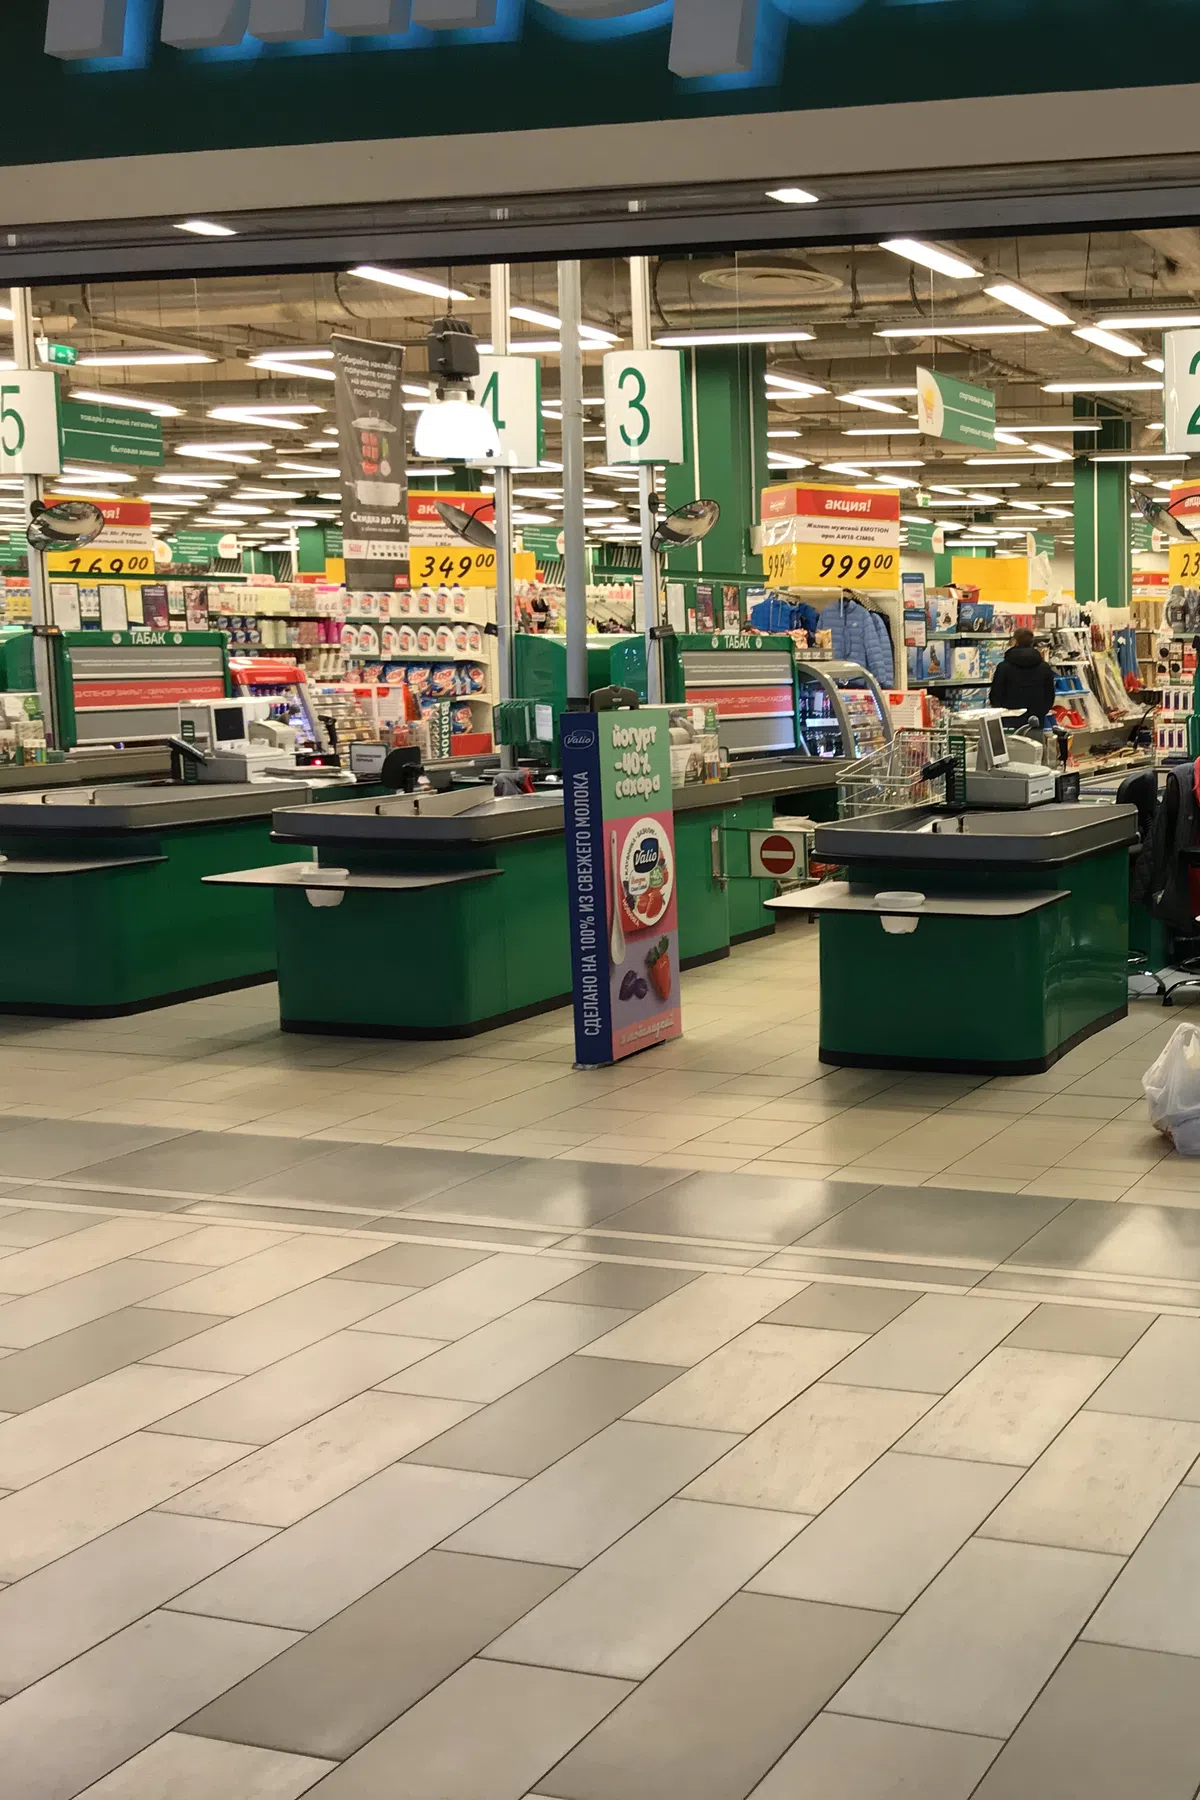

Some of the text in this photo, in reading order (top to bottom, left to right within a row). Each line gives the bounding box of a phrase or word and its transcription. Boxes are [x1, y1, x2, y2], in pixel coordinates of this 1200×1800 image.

[618, 367, 651, 447] 3
[0, 385, 26, 456] 5
[825, 499, 872, 513] акция!
[350, 511, 407, 525] Скидка до 79%
[860, 525, 889, 533] EMOTION
[129, 631, 166, 645] ТАБАК
[724, 635, 751, 649] ТАБАК
[440, 707, 450, 758] BORJOM
[566, 734, 592, 745] Valio
[614, 751, 652, 776] -40%
[615, 774, 661, 801] сахара
[635, 848, 657, 866] Valio
[573, 771, 600, 1036] СДЕЛАНО НА 100% ИЗ СВЕЖЕГО МОЛОКА
